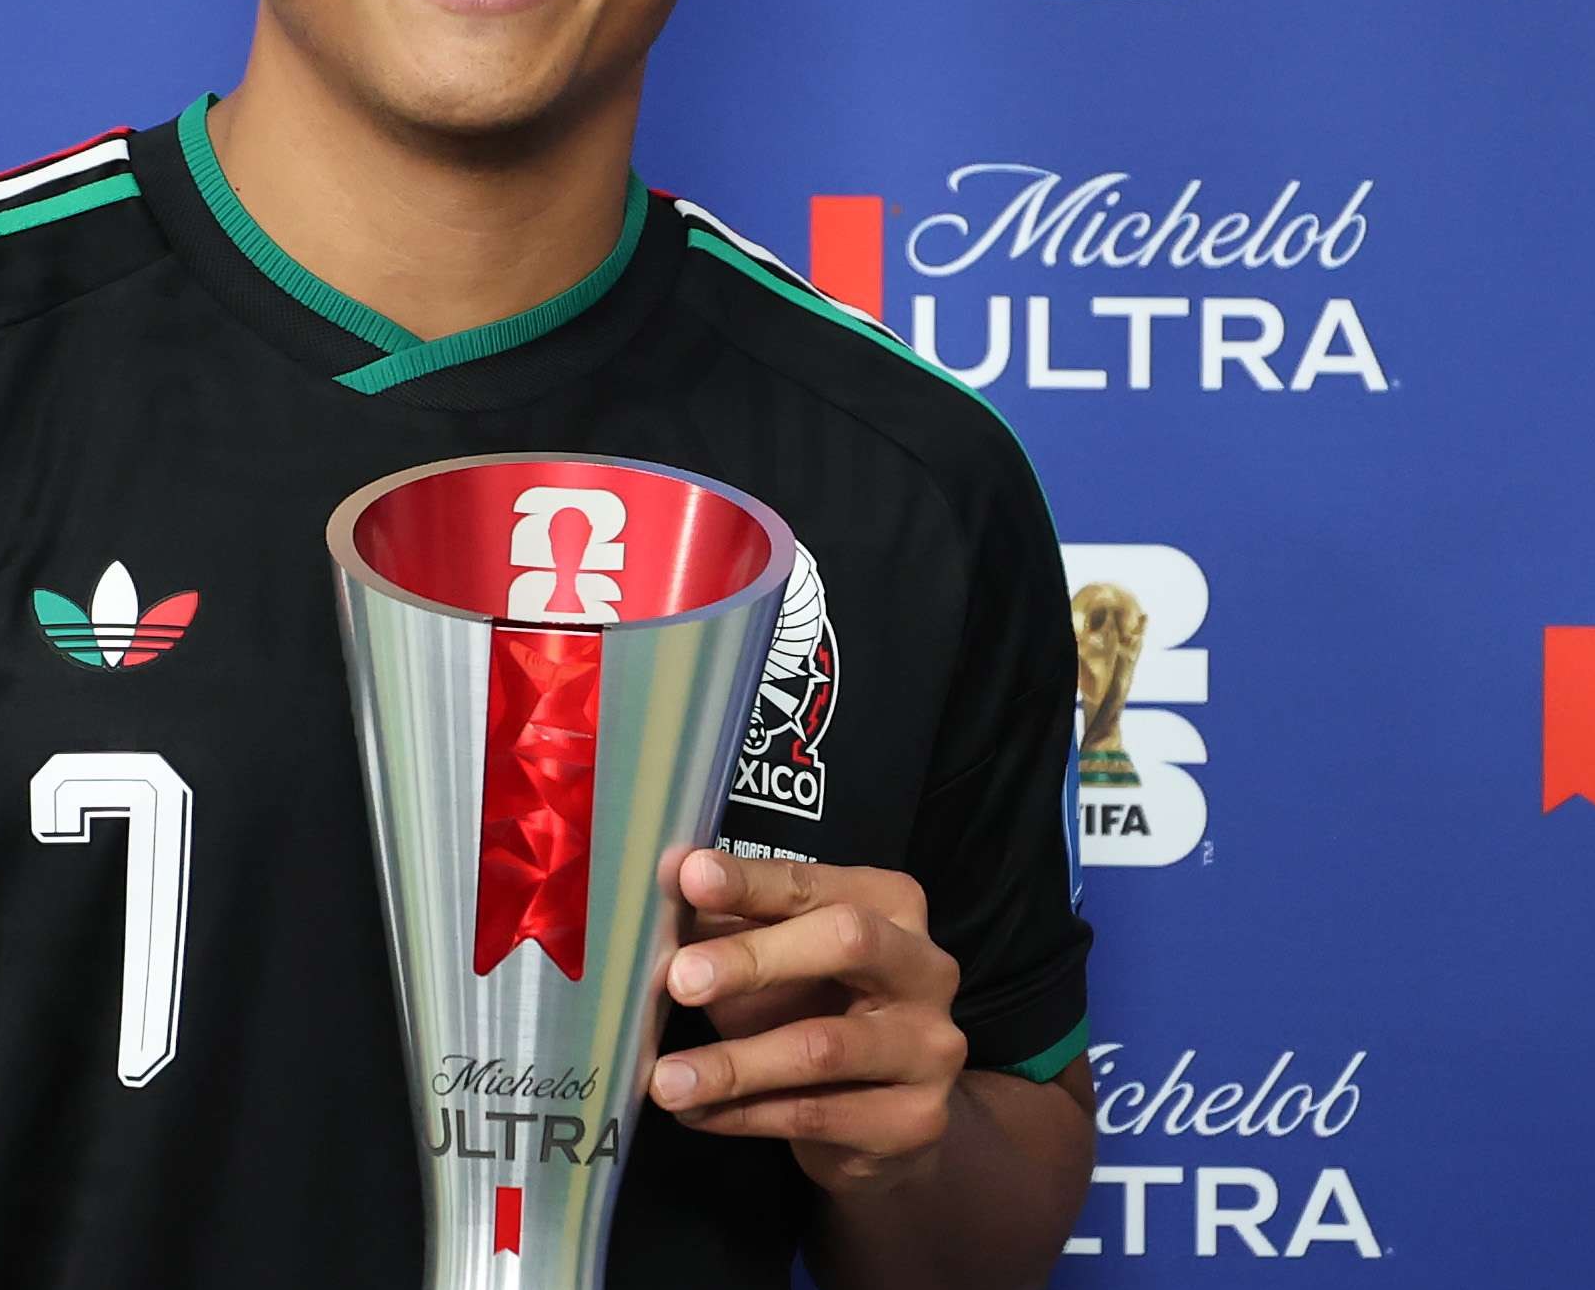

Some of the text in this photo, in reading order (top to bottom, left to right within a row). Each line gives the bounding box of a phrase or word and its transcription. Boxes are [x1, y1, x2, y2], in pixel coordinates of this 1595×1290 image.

[906, 164, 1373, 276] Michelob
[734, 757, 819, 807] XICO
[1081, 804, 1151, 835] IFA
[30, 752, 192, 1088] 7
[432, 1054, 600, 1101] Michelob
[1088, 1043, 1366, 1137] chelob
[426, 1107, 620, 1167] ULTRA
[1062, 1166, 1382, 1258] TRA
